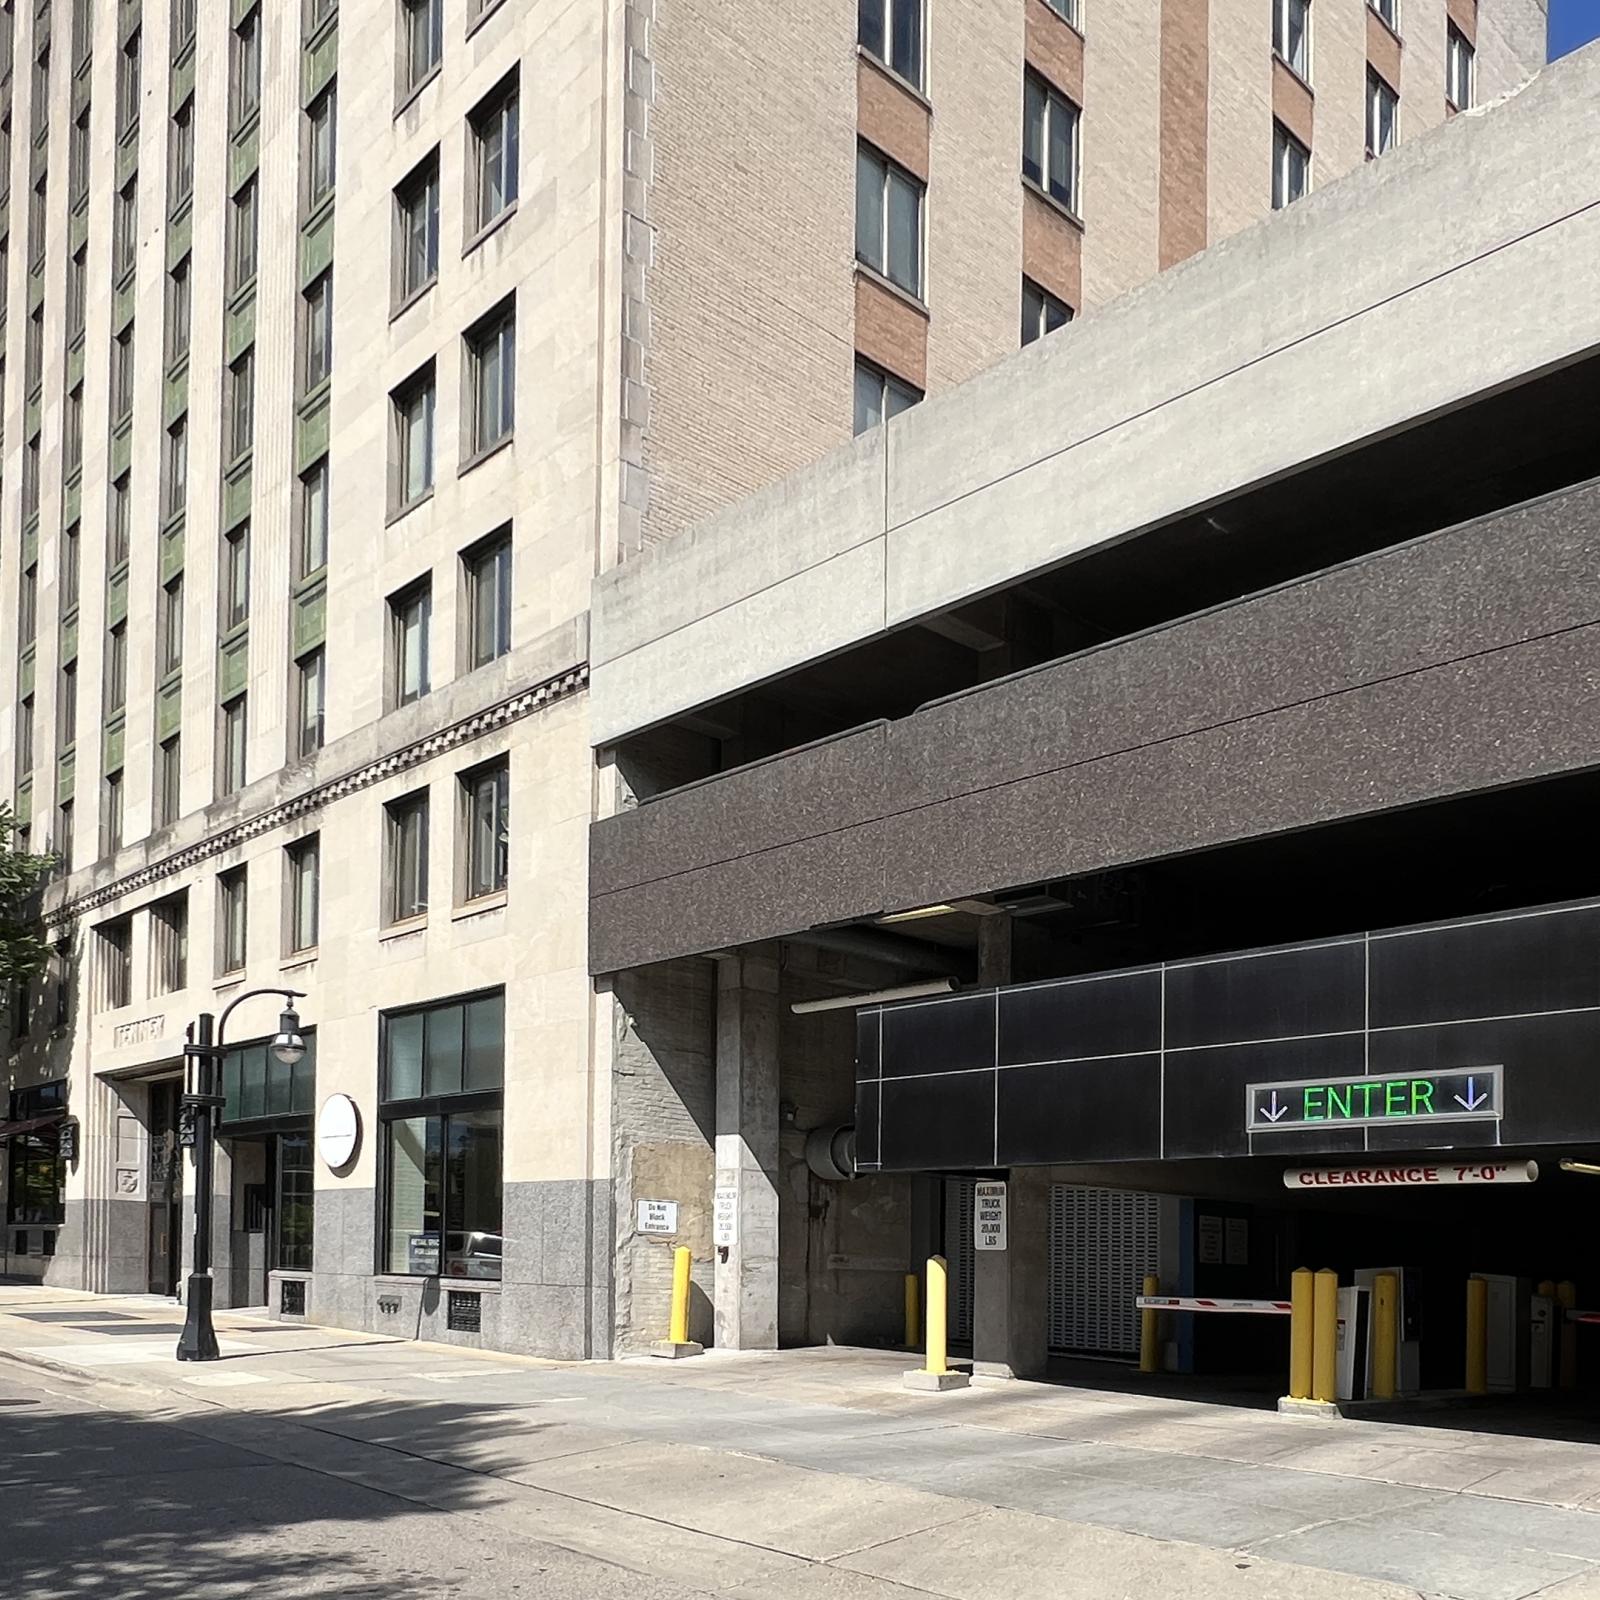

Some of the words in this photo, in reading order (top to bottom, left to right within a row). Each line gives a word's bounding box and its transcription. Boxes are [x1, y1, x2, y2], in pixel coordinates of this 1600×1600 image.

[1303, 1080, 1435, 1121] ENTER
[1299, 1167, 1439, 1186] CLEARANCE
[976, 1185, 1005, 1196] MAXIMUM
[648, 1203, 656, 1211] Do
[981, 1198, 1001, 1209] TRUCK
[649, 1212, 665, 1221] Block
[979, 1211, 1002, 1221] WEIGHT
[644, 1221, 670, 1231] Entrance
[985, 1235, 997, 1246] LBS
